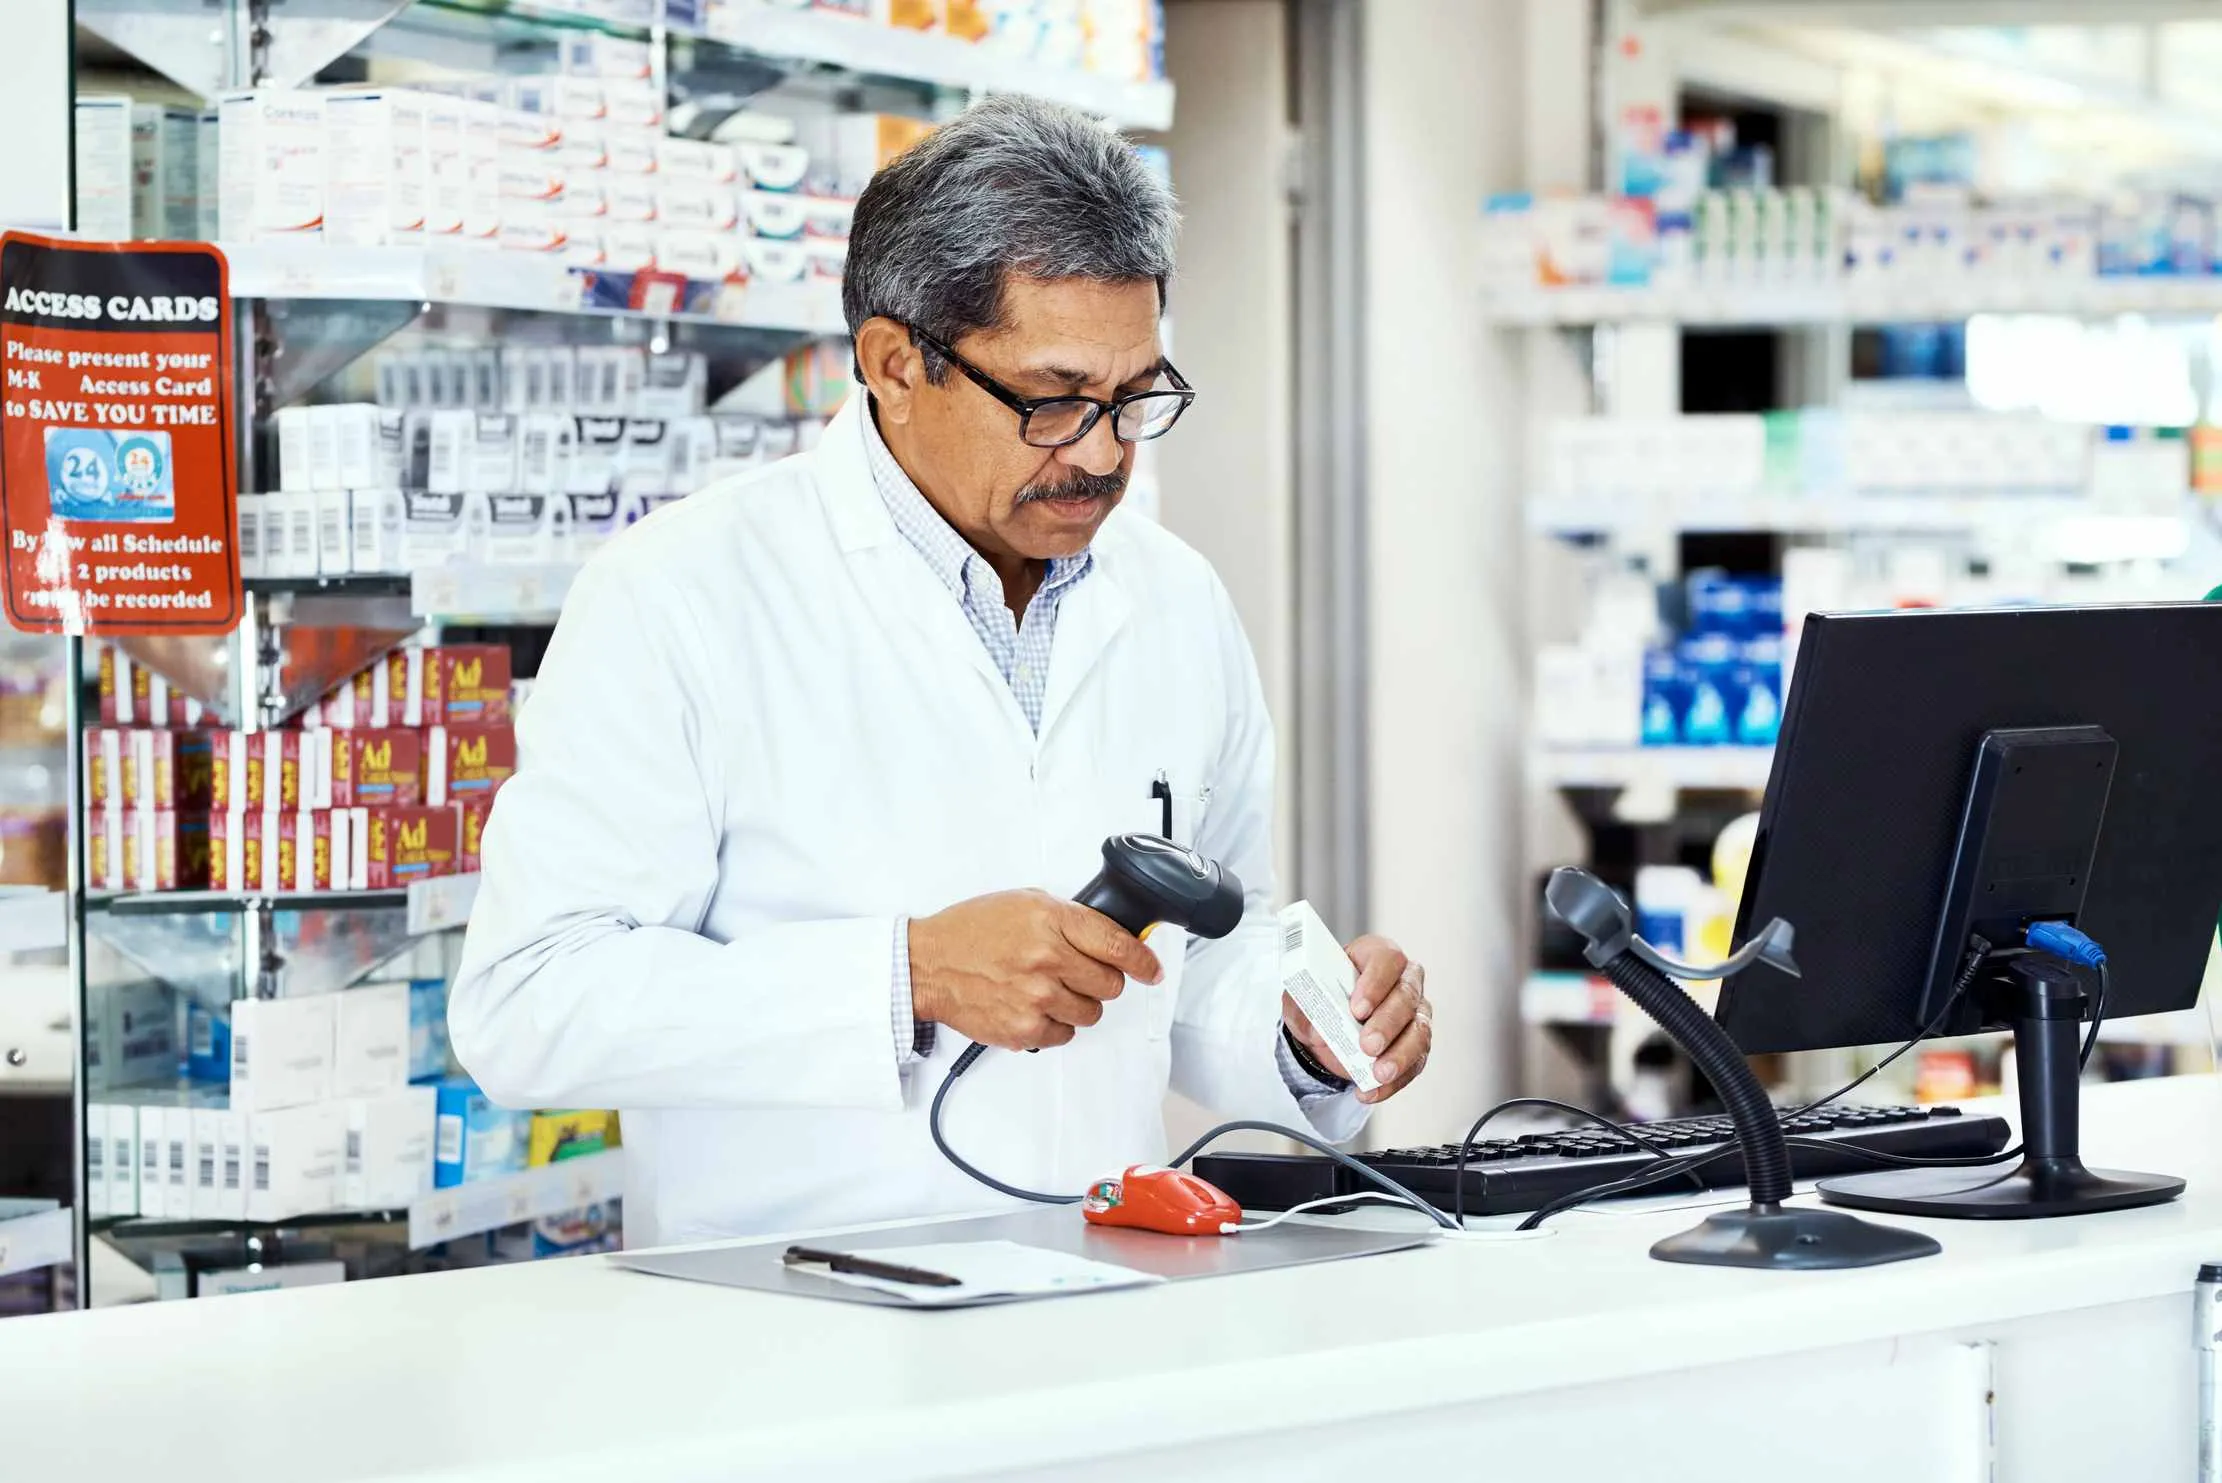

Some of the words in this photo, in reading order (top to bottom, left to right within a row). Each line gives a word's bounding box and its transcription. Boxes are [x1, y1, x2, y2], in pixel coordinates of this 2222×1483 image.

[4, 286, 102, 320] ACCESS
[107, 296, 219, 321] CARDS
[7, 340, 63, 364] Please
[67, 351, 151, 368] present
[155, 353, 212, 372] your
[80, 375, 151, 395] Access
[155, 377, 212, 396] Card
[6, 400, 25, 417] to
[29, 399, 89, 422] SAVE
[93, 403, 146, 424] YOU
[151, 405, 217, 425] TIME
[67, 455, 101, 480] 24
[12, 529, 38, 552] By
[91, 534, 118, 553] all
[123, 534, 223, 555] Schedule
[77, 563, 90, 580] 2
[95, 562, 193, 583] products
[85, 589, 109, 608] be
[115, 590, 212, 609] recorded
